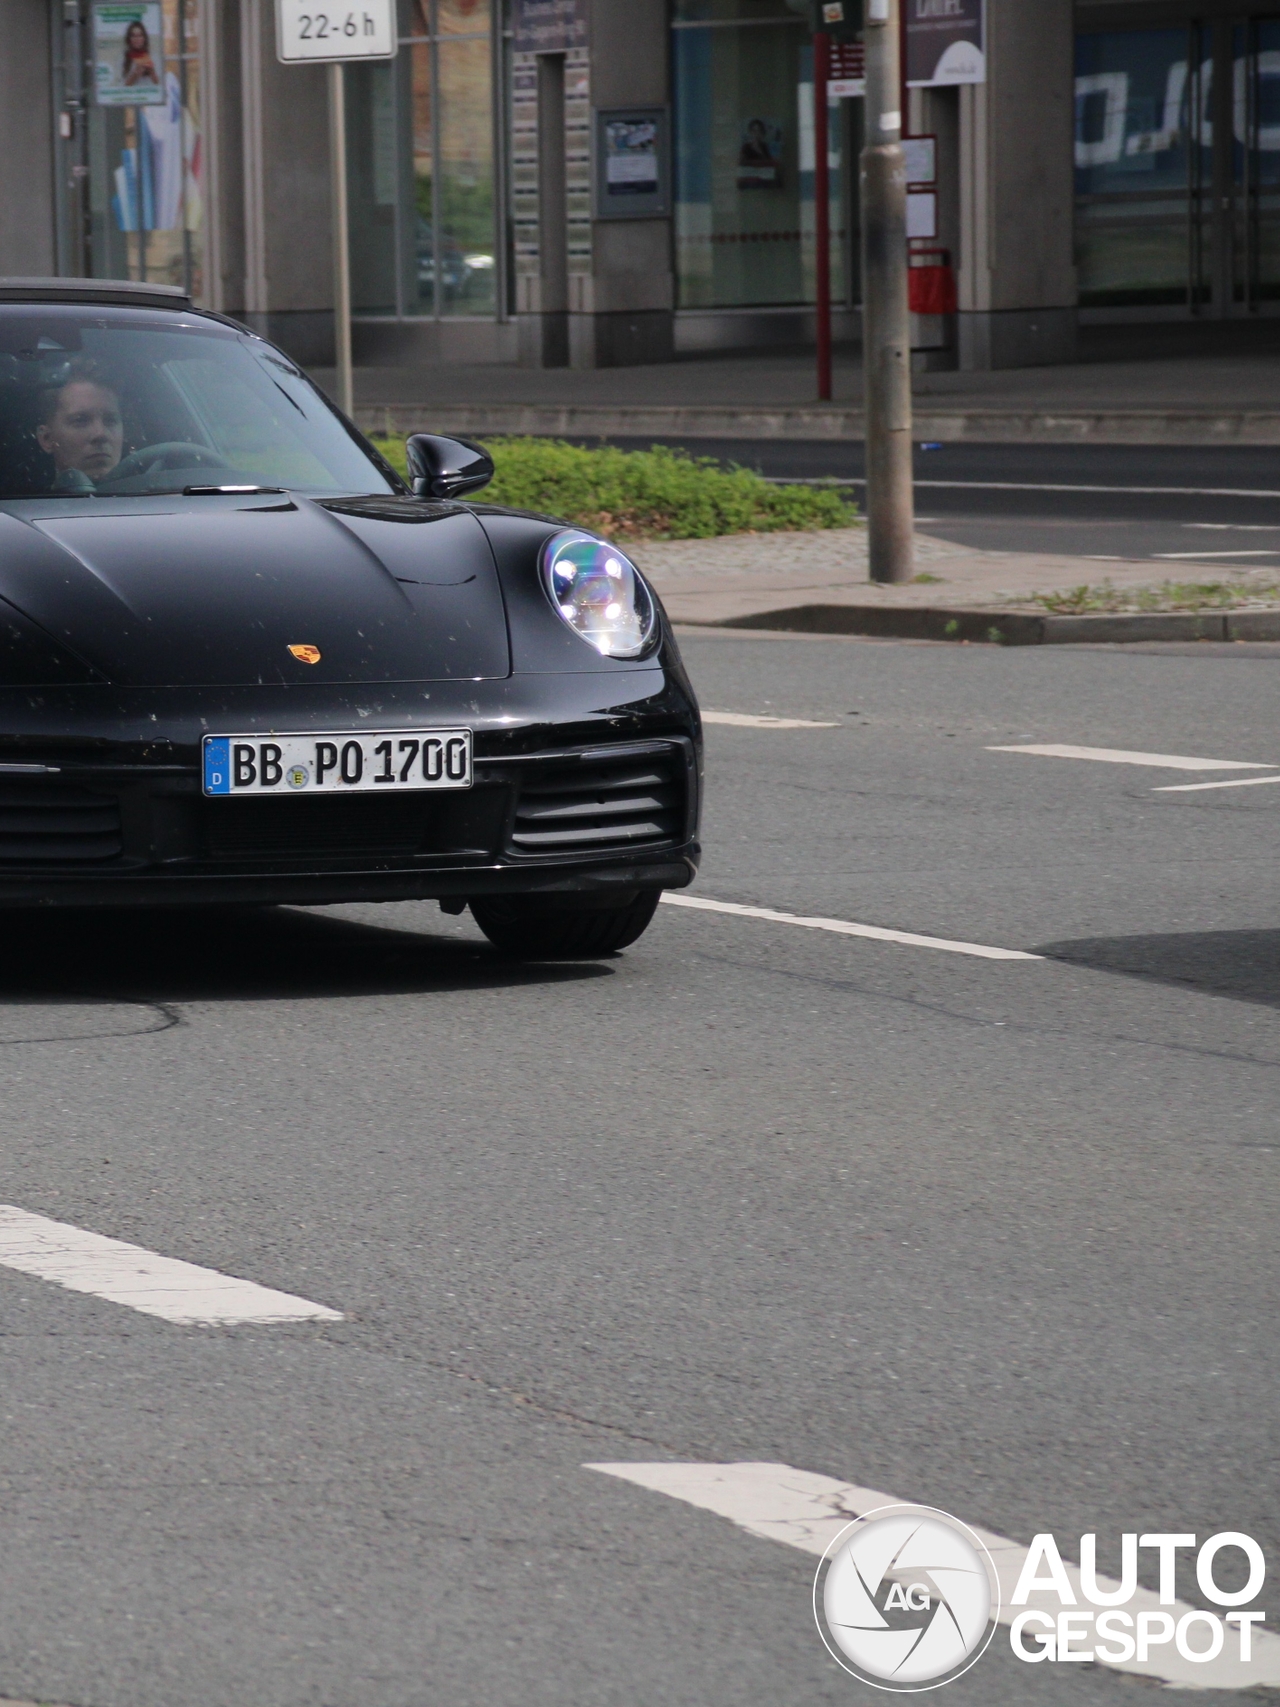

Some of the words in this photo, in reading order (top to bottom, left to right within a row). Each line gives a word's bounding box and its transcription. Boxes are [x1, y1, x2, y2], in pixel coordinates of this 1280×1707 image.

[212, 772, 222, 785] D
[233, 743, 284, 787] BB
[315, 739, 364, 786] PO
[373, 737, 467, 783] 1700
